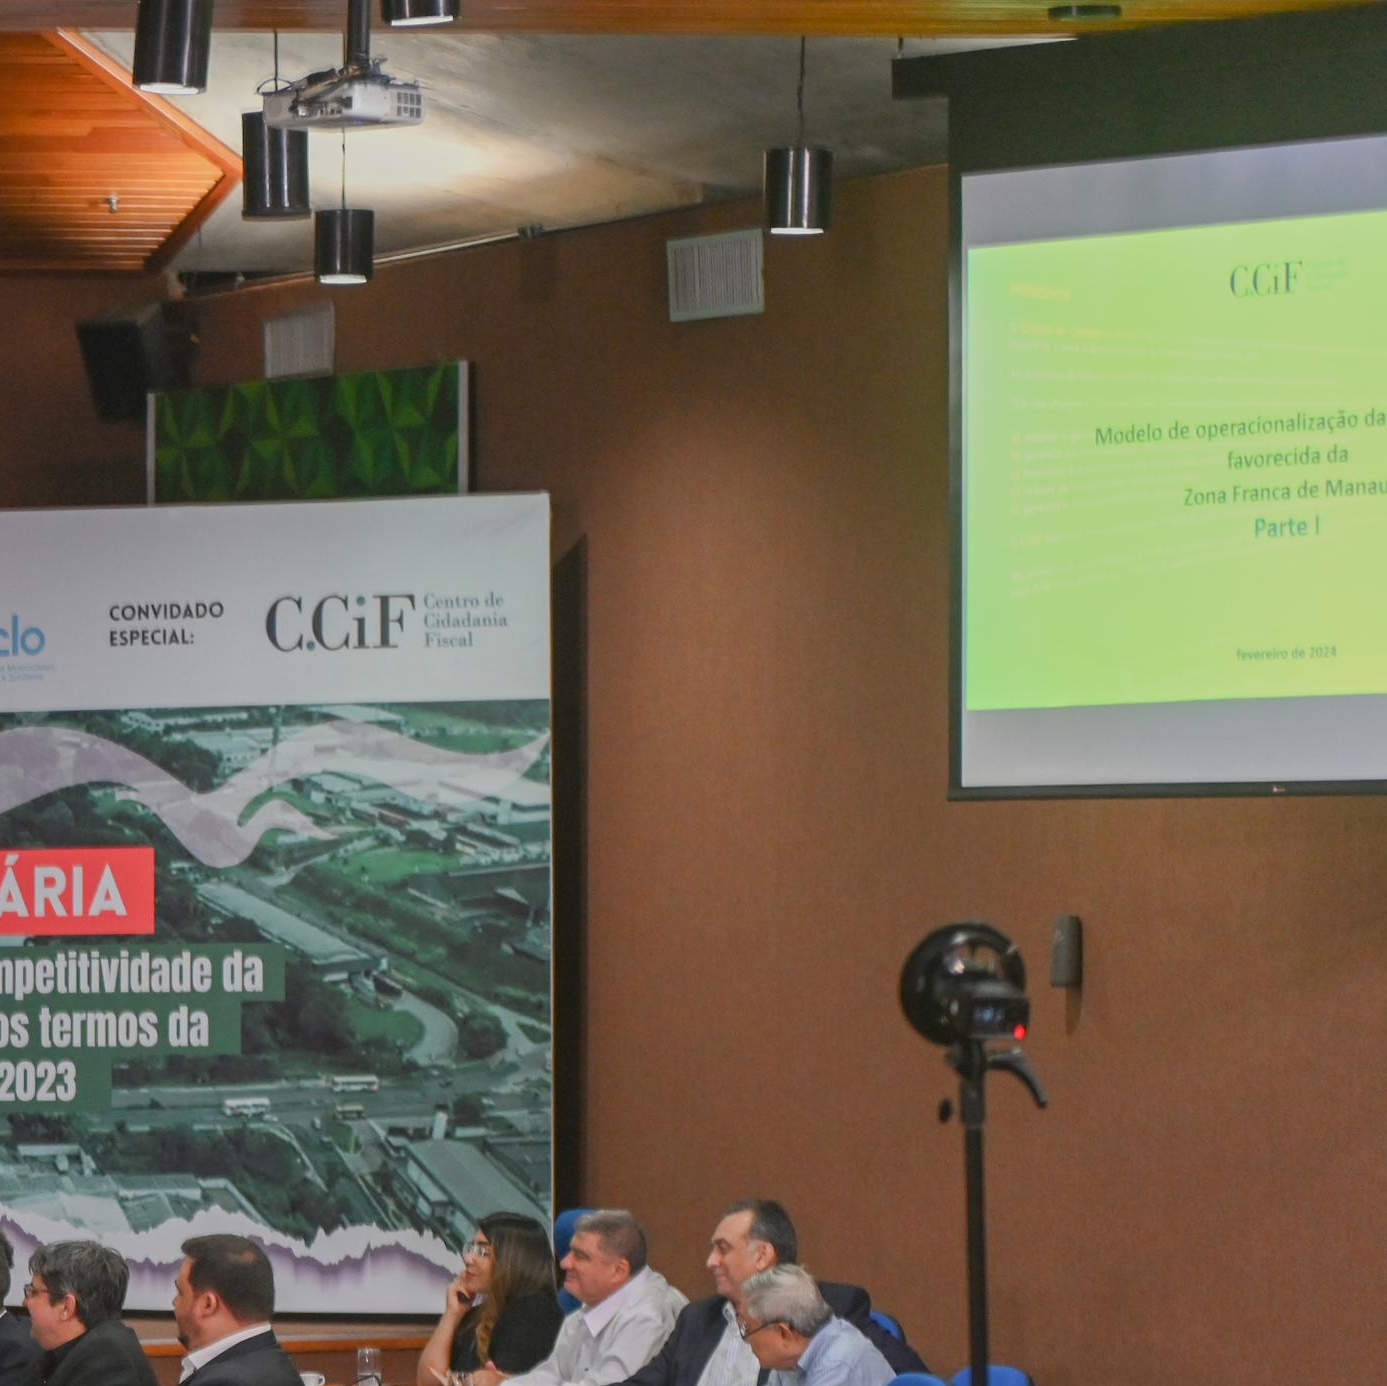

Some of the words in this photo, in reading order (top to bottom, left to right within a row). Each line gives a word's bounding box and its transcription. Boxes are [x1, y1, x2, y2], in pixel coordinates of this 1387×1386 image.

[1094, 422, 1163, 446] Modelo
[1168, 421, 1190, 440] de
[1195, 411, 1359, 441] operacionalização
[1364, 408, 1387, 427] da
[1227, 447, 1321, 470] favorecida
[1327, 444, 1348, 463] da
[1183, 488, 1227, 507] Zona
[1232, 481, 1291, 503] Franca
[1297, 480, 1319, 498] de
[1255, 518, 1308, 539] Parte
[424, 593, 480, 610] Centro
[484, 591, 504, 608] de
[109, 602, 224, 622] CONVIDADO
[424, 611, 508, 629] Cidadania
[109, 627, 195, 648] ESPECIAL:
[425, 631, 473, 649] Fiscal
[222, 951, 264, 993] da
[38, 1006, 158, 1048] termos
[168, 1005, 210, 1047] da
